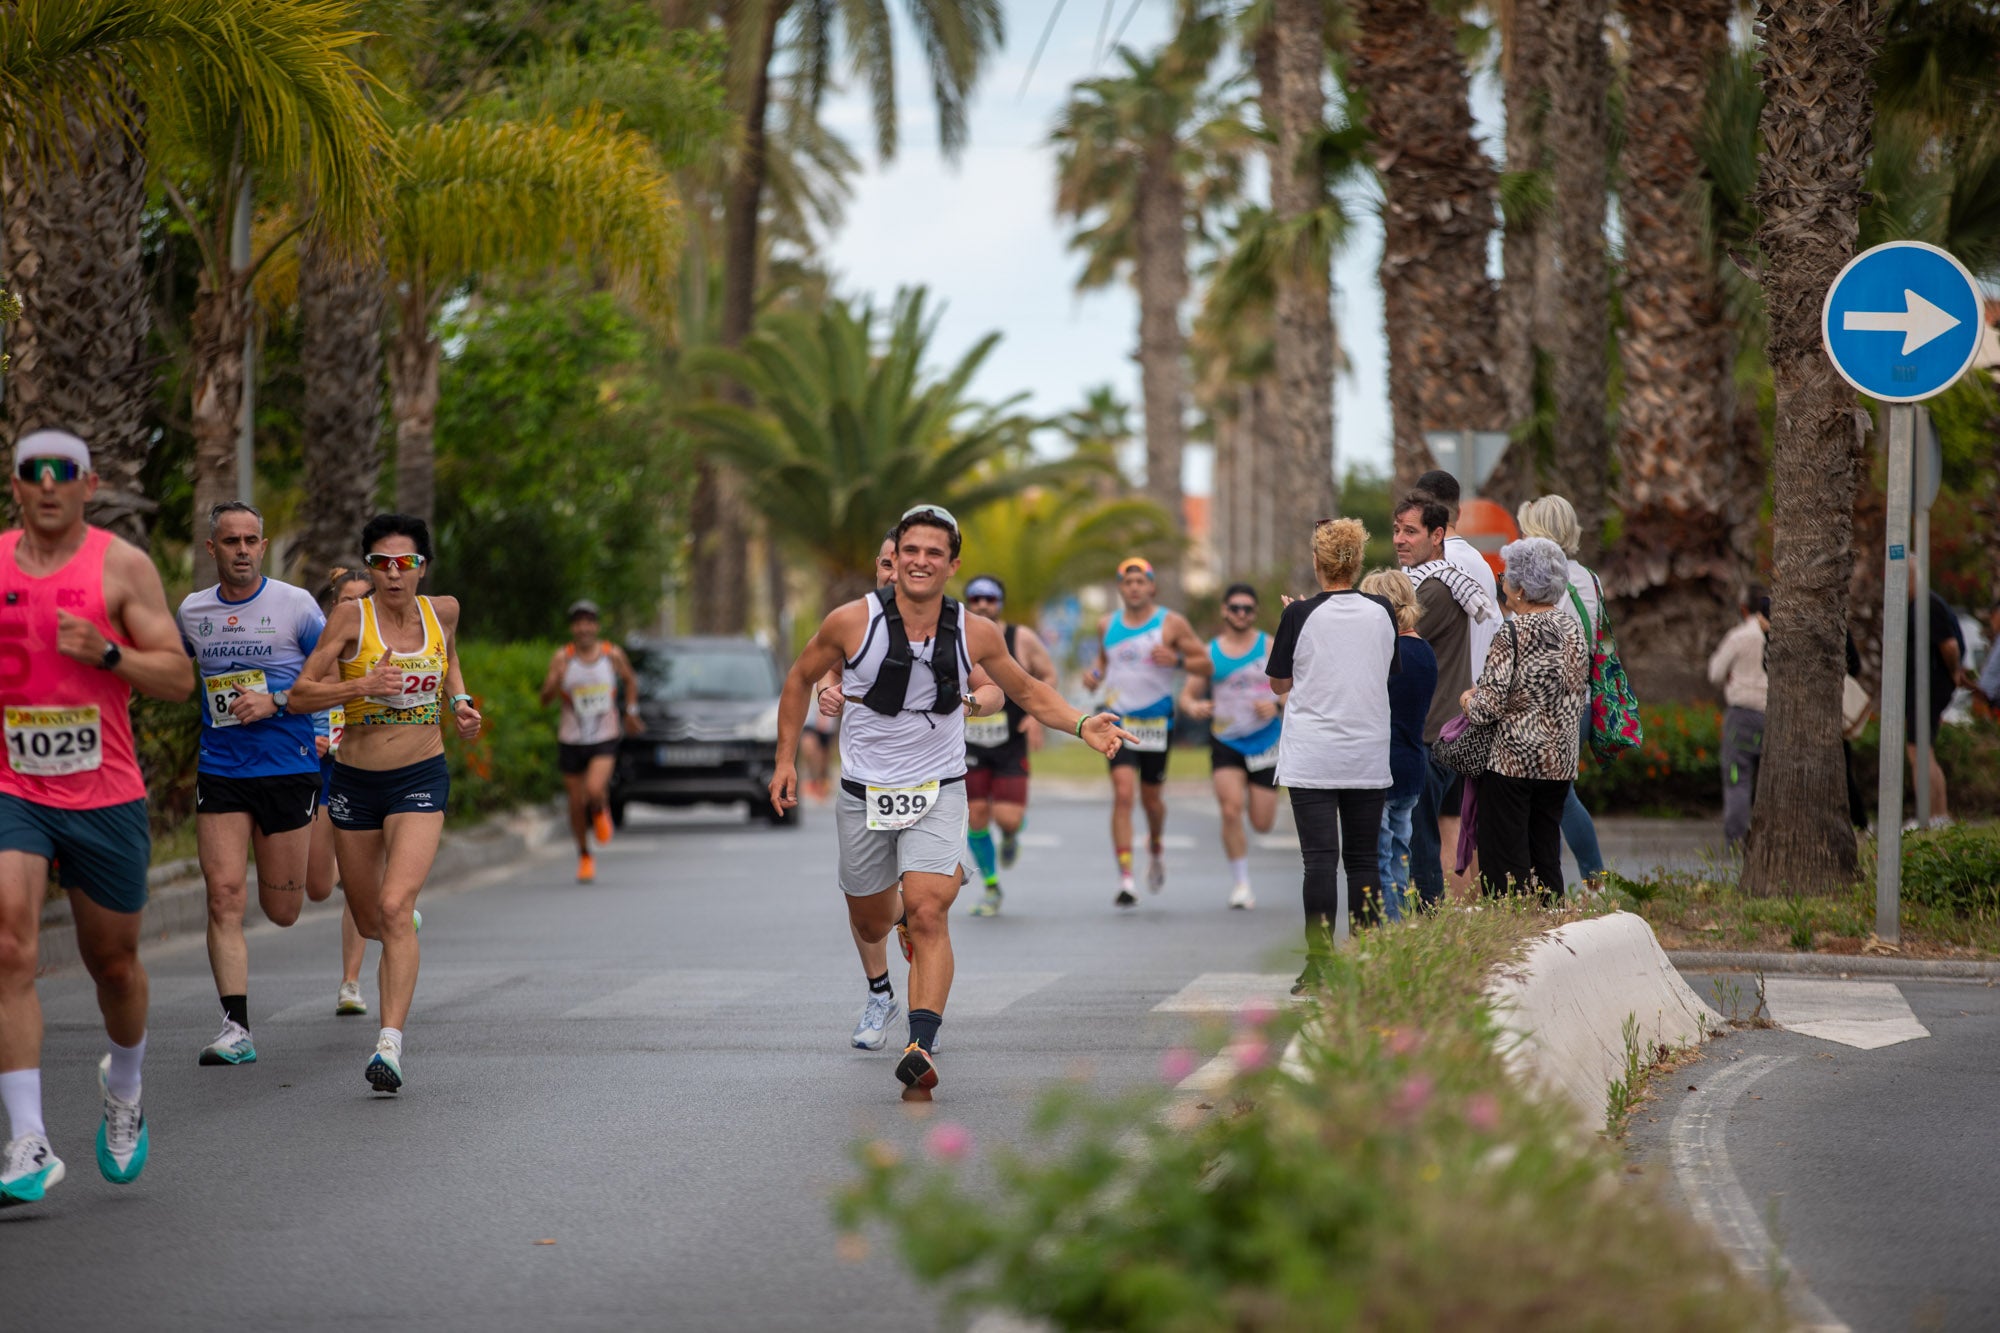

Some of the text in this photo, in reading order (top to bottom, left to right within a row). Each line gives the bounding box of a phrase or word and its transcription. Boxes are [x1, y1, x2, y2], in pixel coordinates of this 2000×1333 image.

[202, 645, 272, 658] MARACENA
[10, 728, 96, 757] 1029
[878, 794, 927, 815] 939
